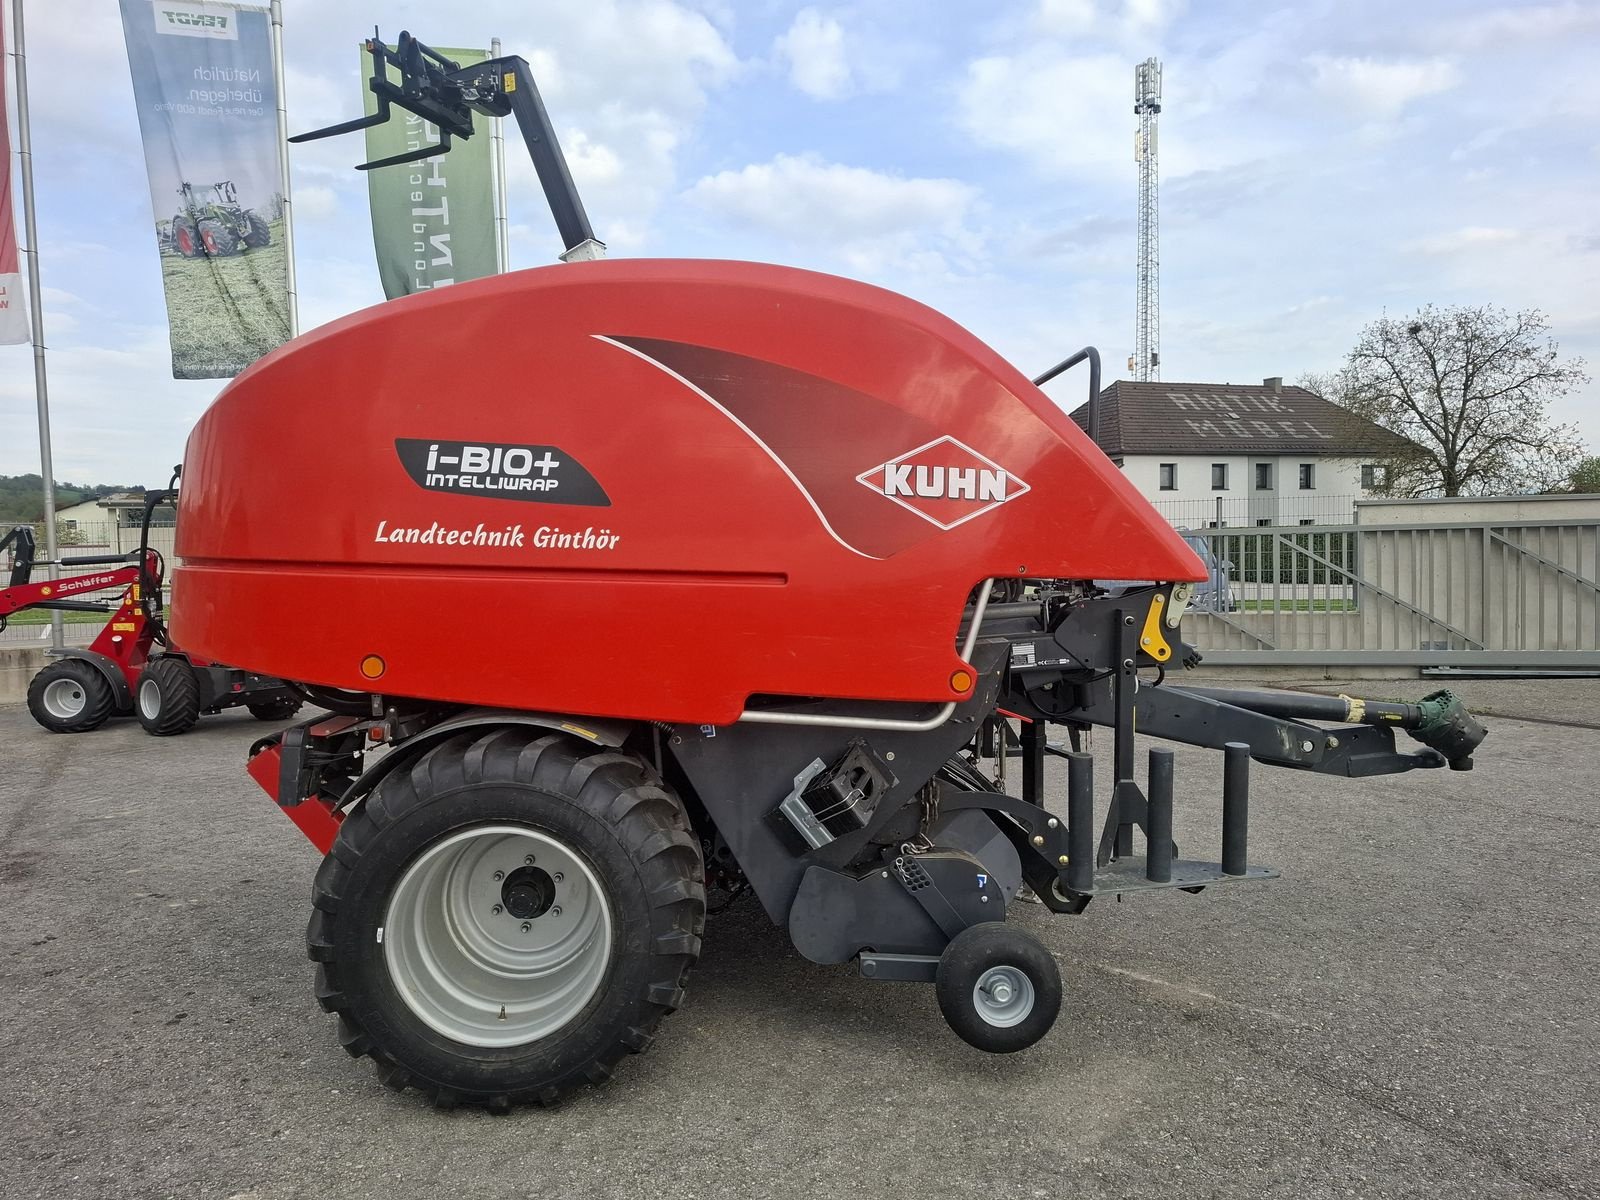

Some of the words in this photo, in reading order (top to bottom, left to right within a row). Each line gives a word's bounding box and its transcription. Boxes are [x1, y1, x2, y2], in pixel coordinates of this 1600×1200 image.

[426, 444, 560, 476] i-BIO+
[425, 473, 559, 491] INTELLIWRAP
[884, 464, 1007, 502] KUHN
[374, 520, 525, 548] Landtechnik
[533, 525, 620, 550] Ginthör
[57, 575, 115, 592] Schäffer
